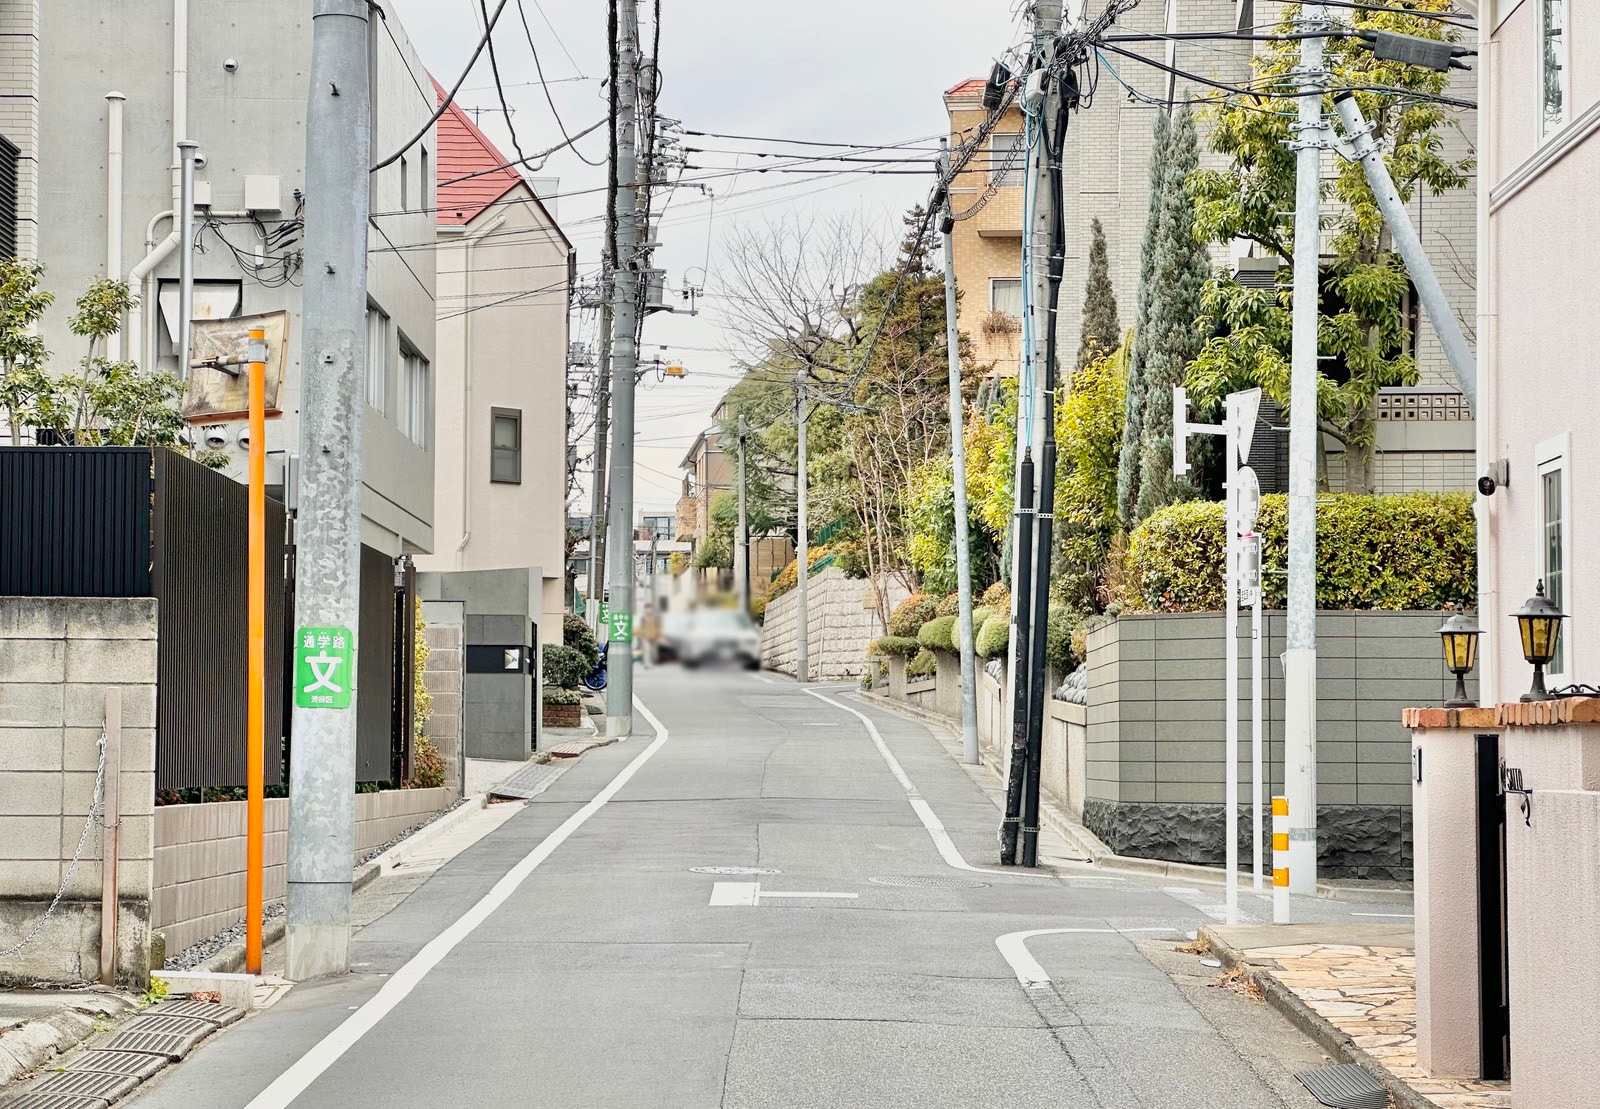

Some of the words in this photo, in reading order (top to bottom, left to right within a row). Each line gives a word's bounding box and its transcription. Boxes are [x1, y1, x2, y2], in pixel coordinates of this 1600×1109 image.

[303, 634, 345, 649] 通学路
[303, 650, 342, 693] 文
